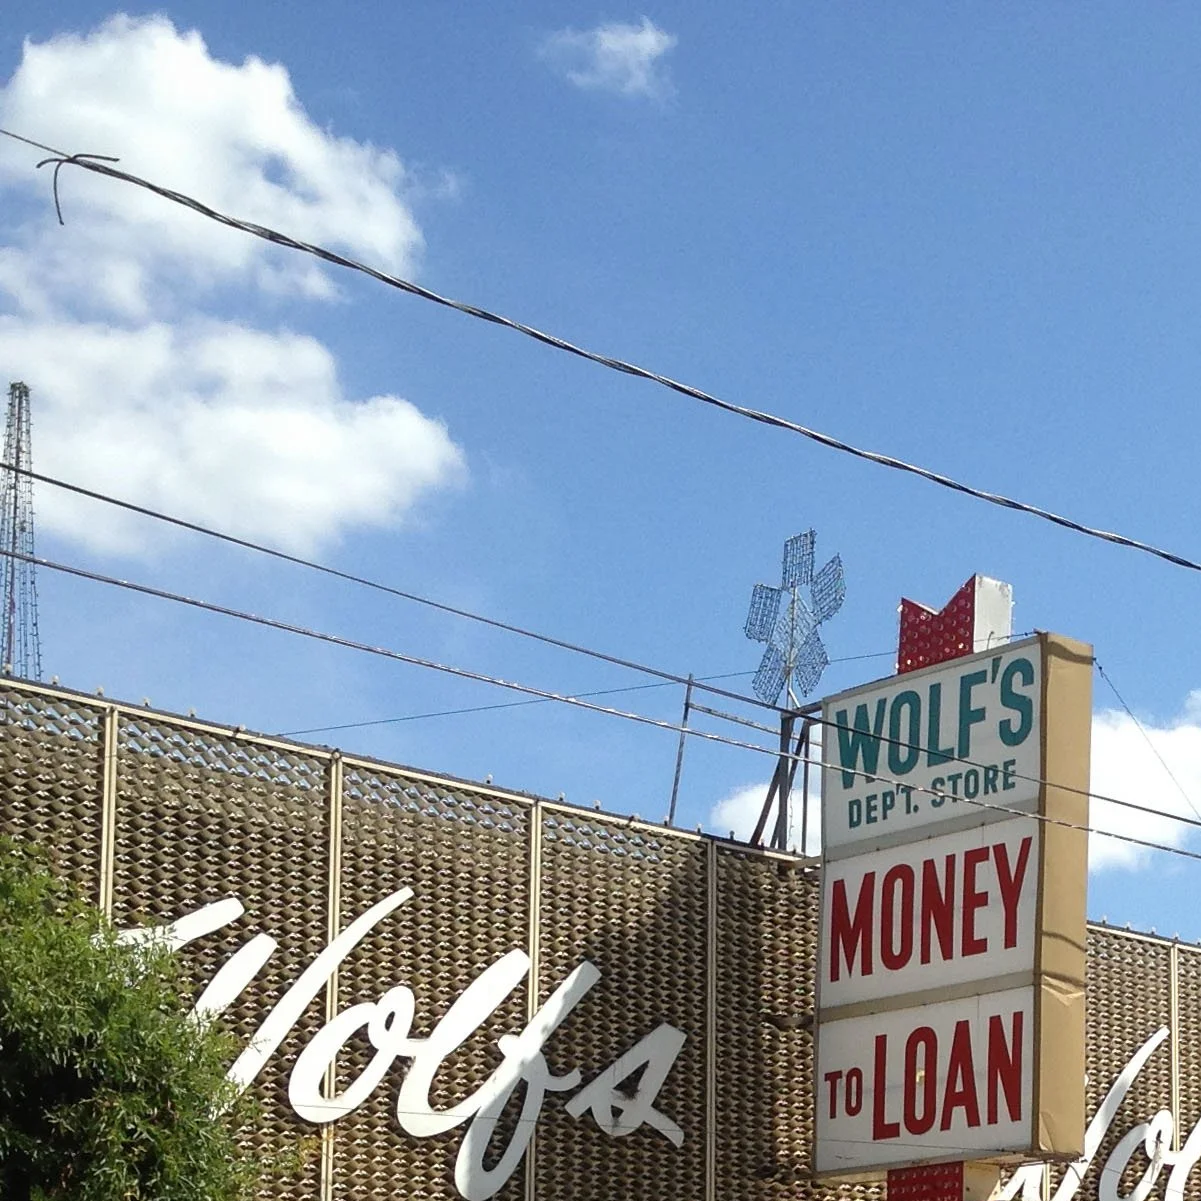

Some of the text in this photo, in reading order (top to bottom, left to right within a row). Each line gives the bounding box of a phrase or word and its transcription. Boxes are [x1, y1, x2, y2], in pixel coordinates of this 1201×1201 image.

[836, 656, 1035, 790] WOLF'S
[931, 759, 1016, 808] STORE
[830, 836, 1032, 982] MONEY
[824, 1011, 1023, 1140] TO LOAN
